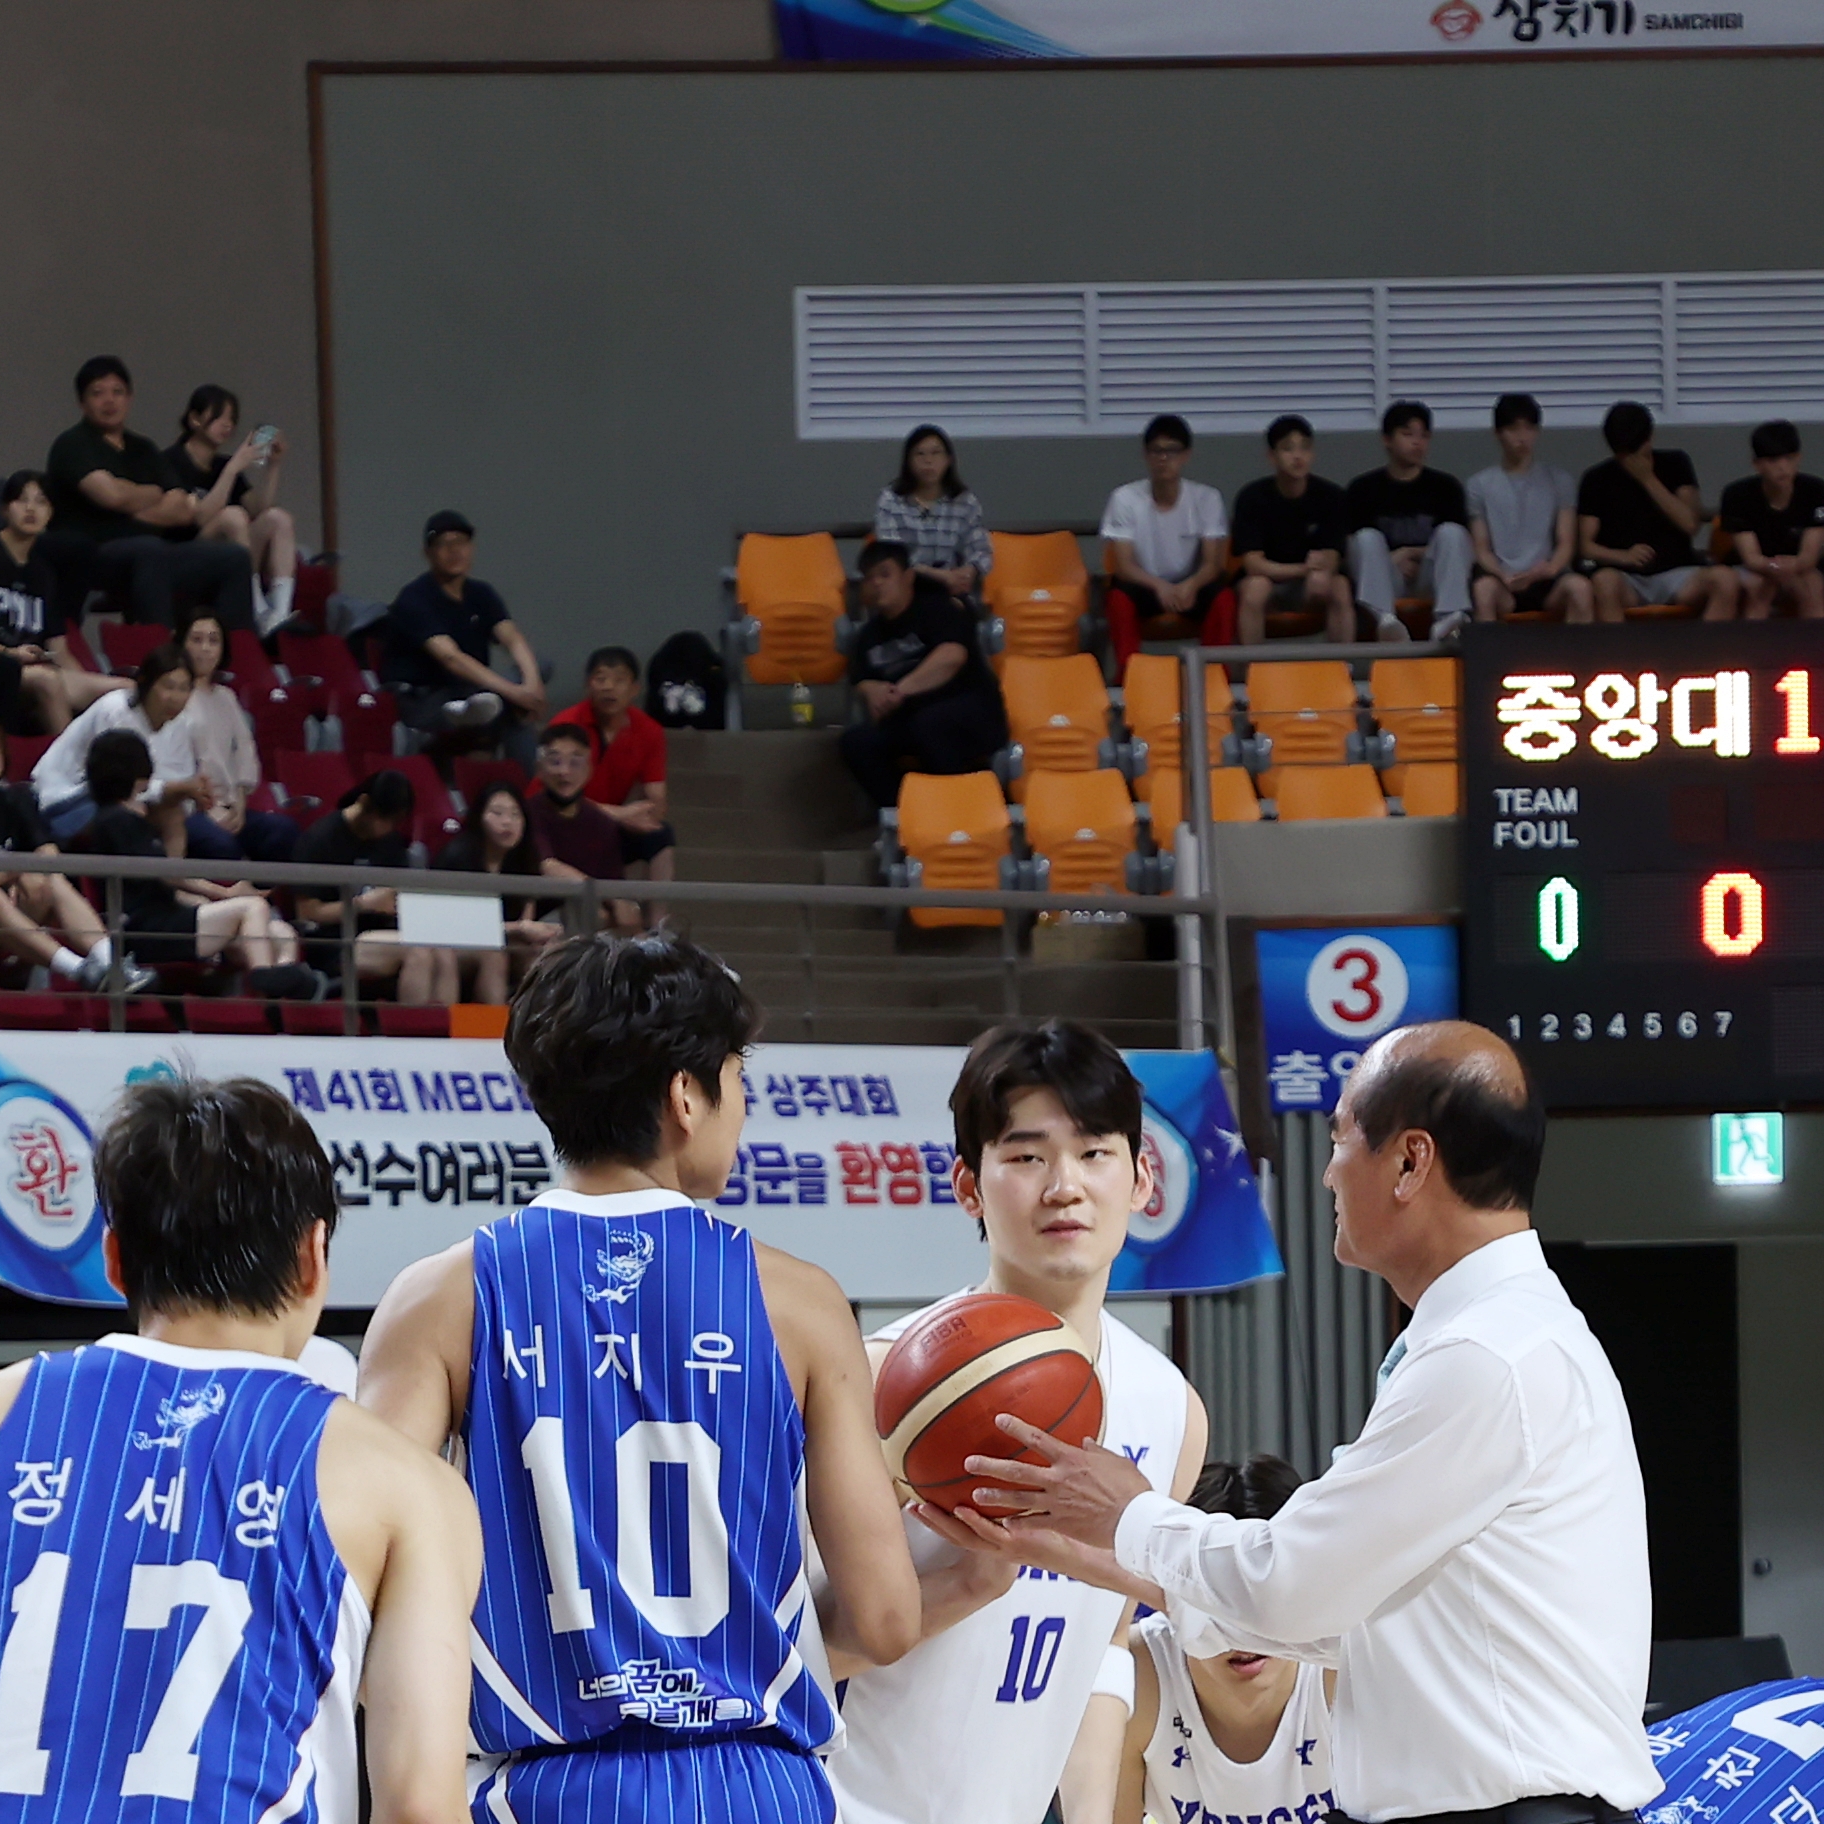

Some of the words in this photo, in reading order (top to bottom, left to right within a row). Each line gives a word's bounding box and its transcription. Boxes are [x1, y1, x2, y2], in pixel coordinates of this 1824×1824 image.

[1497, 671, 1750, 761] 중앙대
[1493, 787, 1579, 815] TEAM
[1493, 821, 1579, 848] FOUL
[1538, 876, 1578, 962] 0
[1701, 872, 1763, 957] 0
[1331, 947, 1384, 1023] 3
[1507, 1013, 1522, 1040] 1
[1539, 1012, 1561, 1041] 2
[1572, 1012, 1593, 1040] 3
[1607, 1011, 1628, 1039] 4
[1642, 1011, 1663, 1039] 5
[1677, 1010, 1699, 1038] 6
[1713, 1009, 1734, 1037] 7
[282, 1066, 409, 1114] 제41회
[410, 1069, 537, 1112] MBC
[767, 1073, 901, 1118] 상주대회
[12, 1125, 80, 1219] 환
[502, 1324, 742, 1395] 서지우
[7, 1456, 287, 1549] 정세영
[521, 1415, 730, 1638] 10
[995, 1616, 1066, 1703] 10
